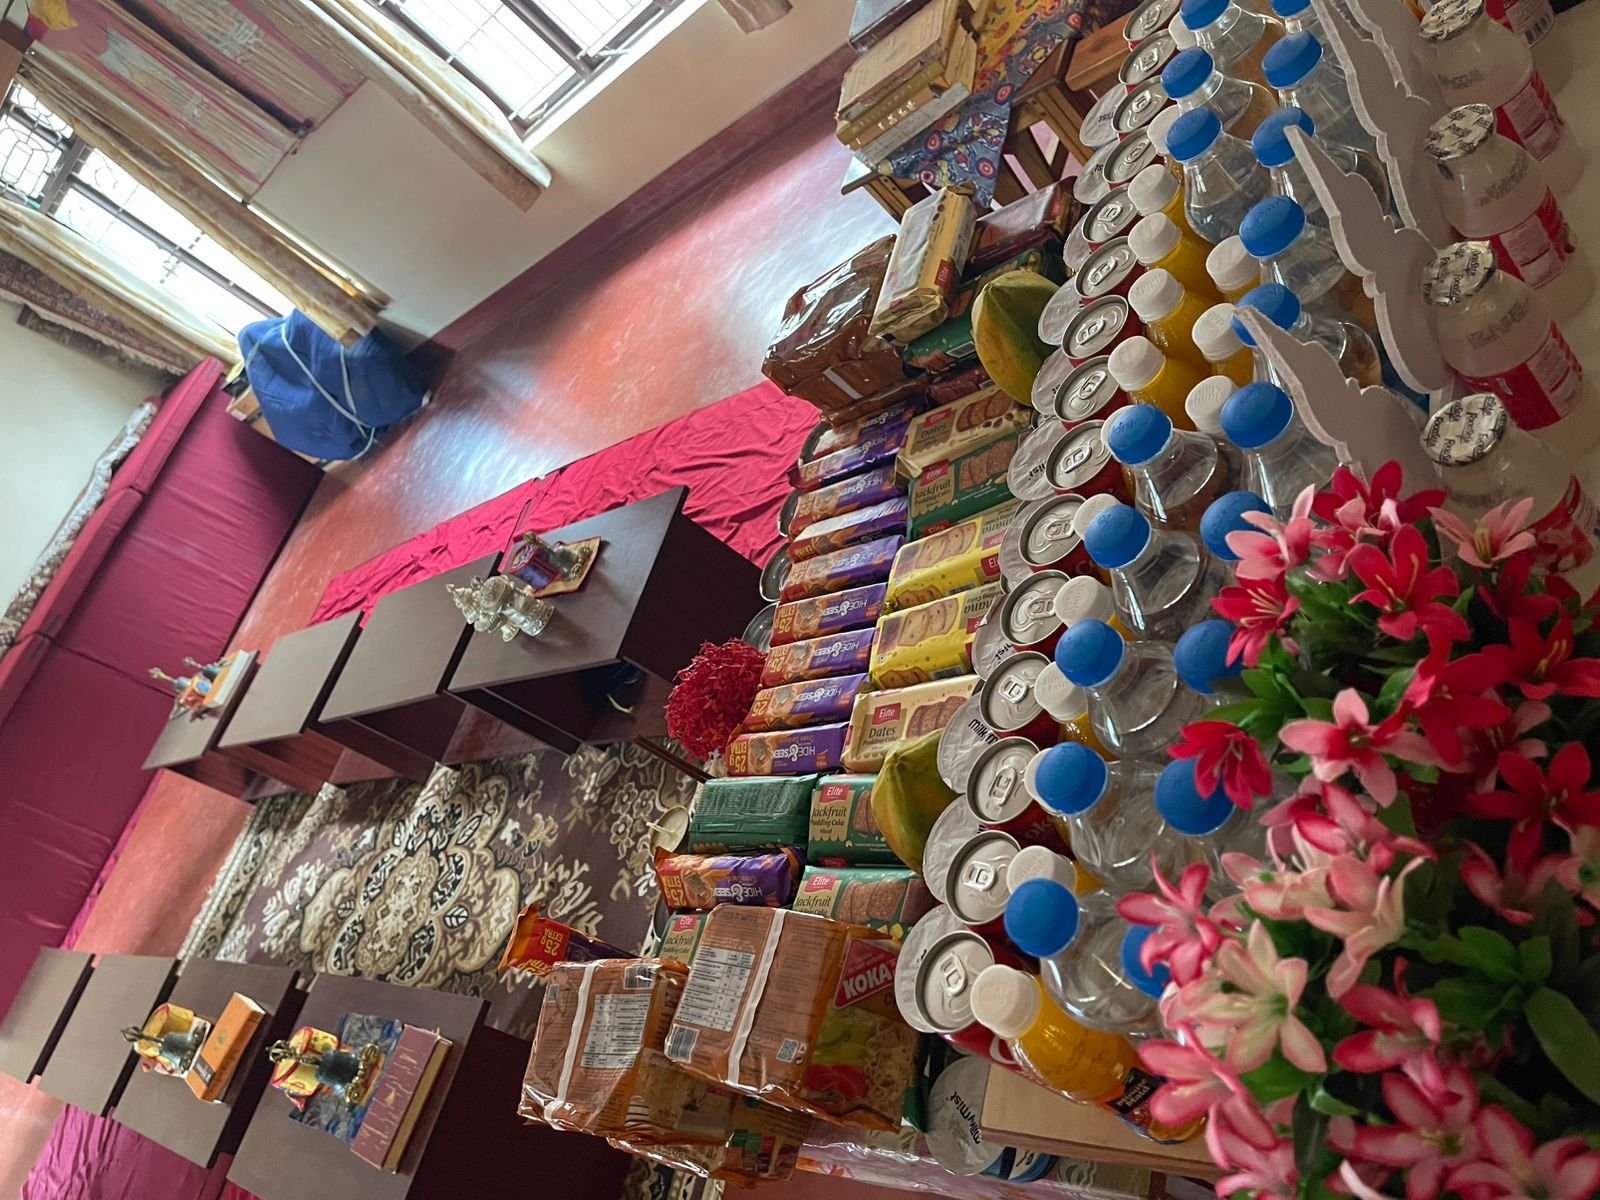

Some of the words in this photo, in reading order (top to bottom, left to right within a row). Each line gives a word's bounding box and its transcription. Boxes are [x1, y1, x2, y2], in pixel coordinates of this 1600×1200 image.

[879, 708, 896, 719] Elite
[868, 726, 897, 739] Dates
[730, 741, 747, 754] EXTRA
[729, 755, 746, 773] 25g
[826, 786, 843, 797] Elite
[811, 805, 848, 820] Jackfruit
[812, 875, 830, 886] Elite
[665, 889, 688, 906] 25g
[544, 928, 564, 942] EXTRA
[540, 936, 561, 956] 25g
[843, 962, 893, 1000] KOKA
